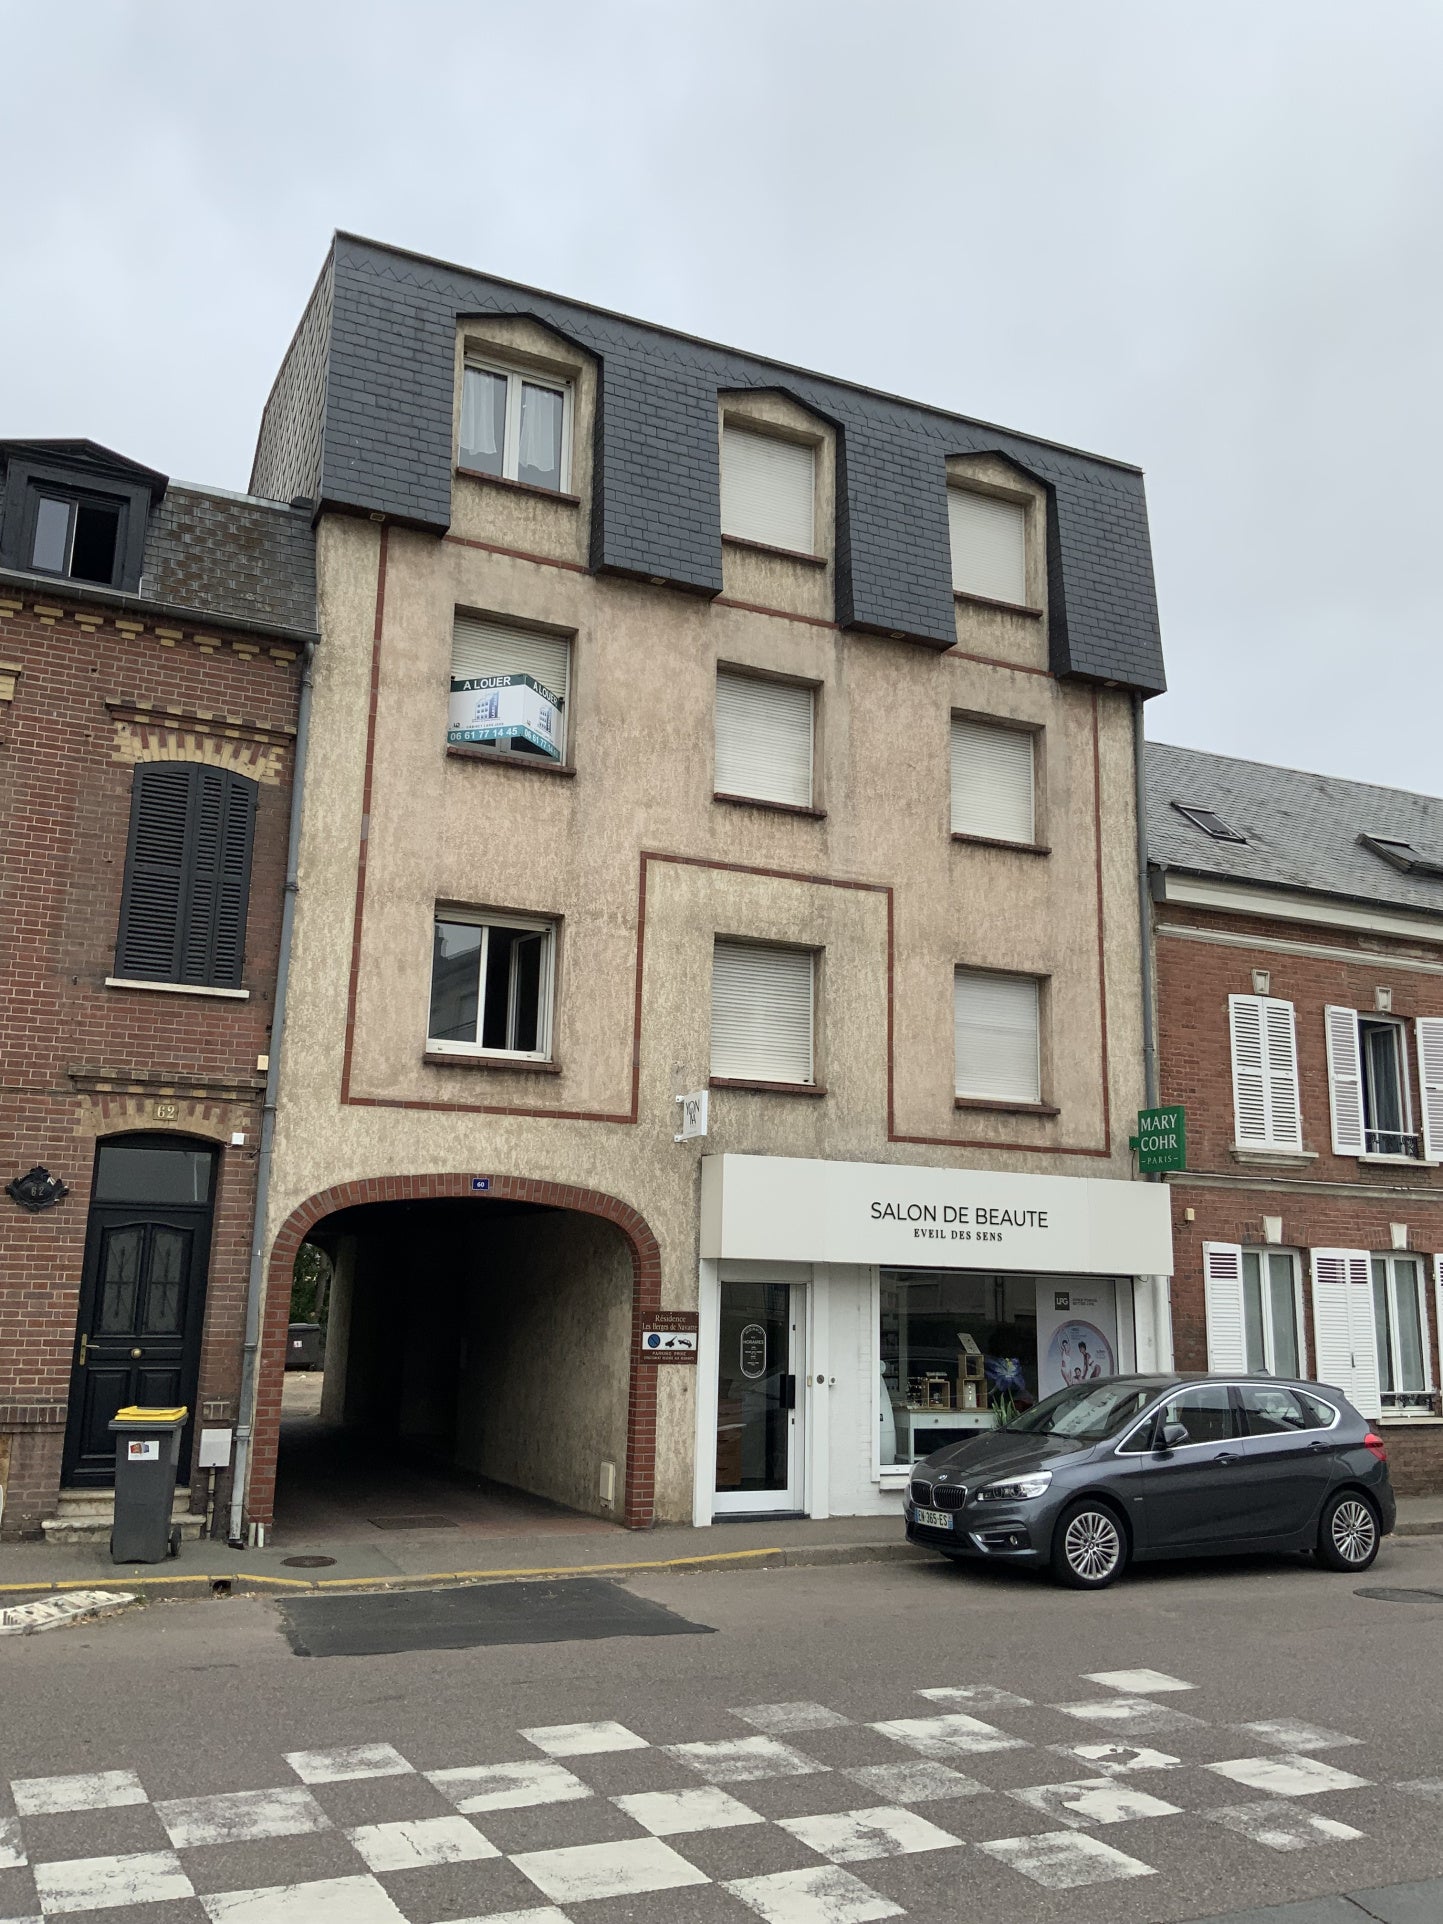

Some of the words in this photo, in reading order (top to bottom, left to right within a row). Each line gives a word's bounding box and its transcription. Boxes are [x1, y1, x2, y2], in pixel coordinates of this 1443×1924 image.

[463, 681, 471, 690] A
[474, 676, 511, 689] LOUER
[533, 681, 538, 692] A
[539, 686, 558, 706] LOUER
[464, 731, 475, 739] 61
[479, 730, 489, 738] 77
[493, 729, 503, 737] 14
[506, 727, 518, 736] 45
[157, 1104, 175, 1119] 62
[1141, 1114, 1178, 1132] MARY
[1141, 1133, 1177, 1151] COHR
[31, 1186, 45, 1197] 62
[871, 1201, 937, 1222] SALON
[943, 1205, 969, 1224] DE
[976, 1207, 1049, 1228] BEAUTE
[913, 1228, 947, 1239] EVEIL
[951, 1229, 972, 1240] DES
[976, 1231, 1003, 1242] SENS
[655, 1314, 687, 1323] Résidence
